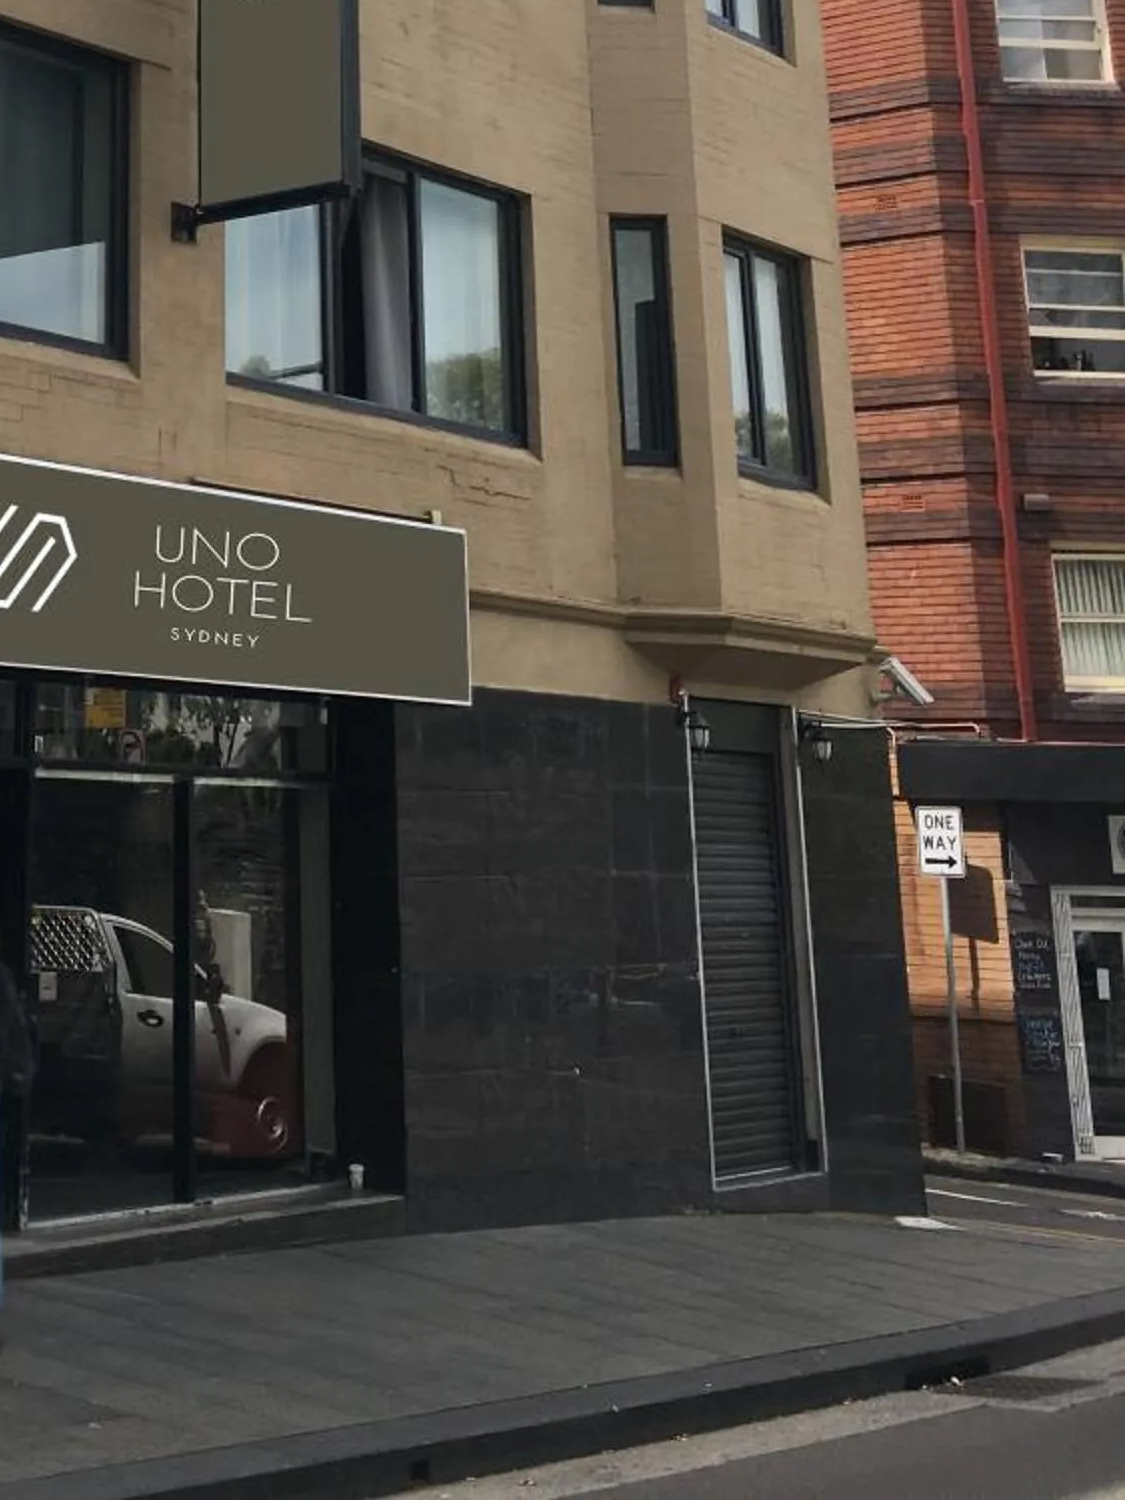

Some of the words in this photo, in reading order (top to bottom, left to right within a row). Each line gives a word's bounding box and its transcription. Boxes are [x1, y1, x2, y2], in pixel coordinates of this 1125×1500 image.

[155, 525, 280, 571] UNO
[134, 570, 313, 624] HOTEL
[170, 627, 261, 649] SYDNEY
[924, 814, 955, 830] ONE
[923, 835, 957, 851] WAY
